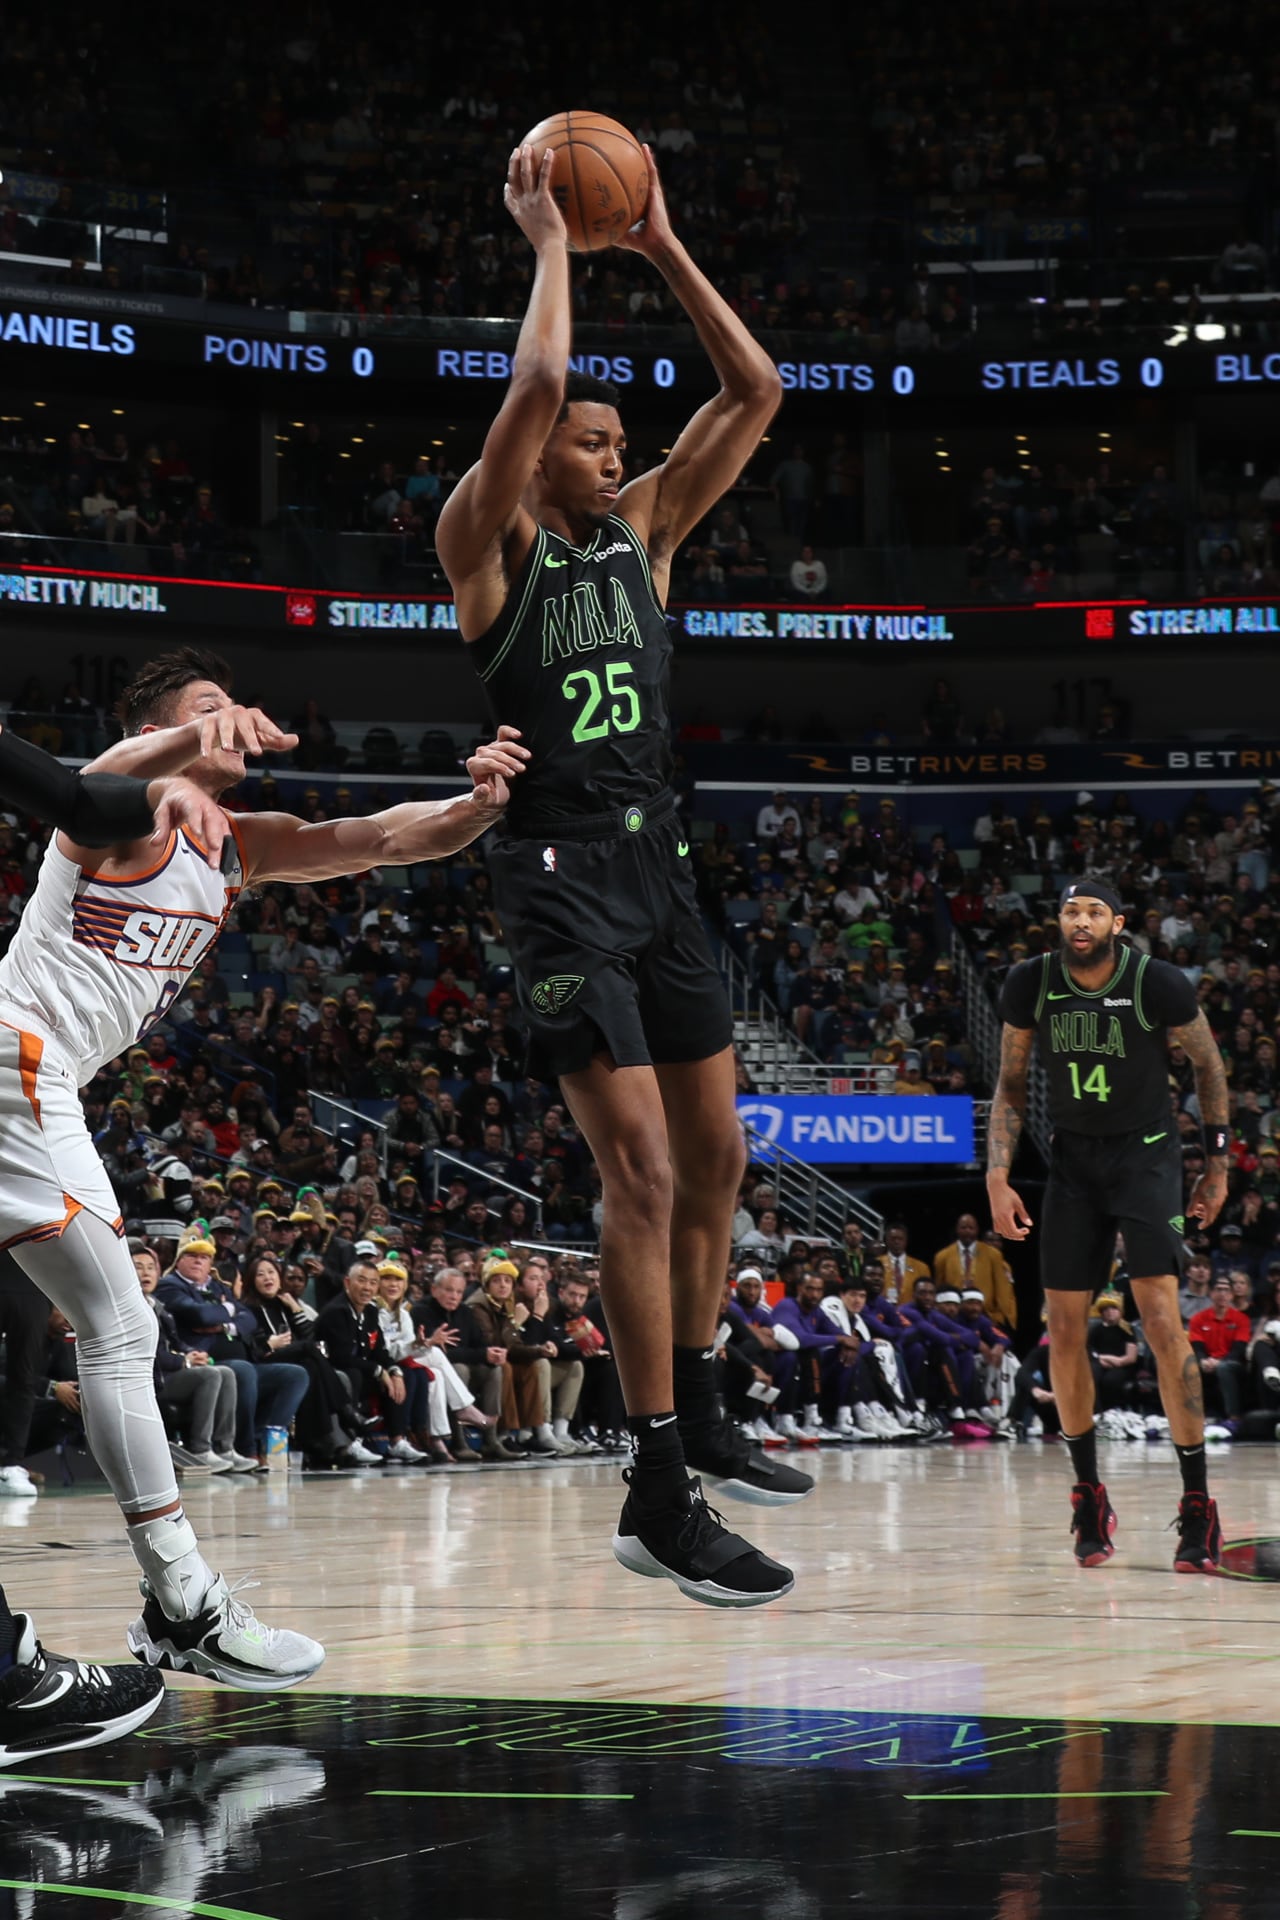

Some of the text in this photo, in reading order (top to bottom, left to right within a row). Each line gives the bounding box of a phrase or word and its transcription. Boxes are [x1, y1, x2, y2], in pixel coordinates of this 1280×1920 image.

[120, 300, 164, 313] TICKETS
[0, 311, 136, 355] ANIELS
[203, 335, 328, 373] POINTS
[352, 347, 374, 377] 0
[437, 350, 634, 383] REBNDS
[653, 358, 675, 388] 0
[777, 362, 875, 391] SISTS
[892, 365, 915, 395] 0
[982, 360, 1121, 389] STEALS
[1140, 357, 1163, 388] 0
[592, 541, 632, 563] ibotta
[89, 581, 166, 612] MUCH.
[328, 601, 427, 628] STREAM
[430, 604, 458, 630] AL
[541, 577, 643, 666] NOLA
[684, 610, 953, 640] GAMES. PRETTY MUCH.
[1129, 607, 1280, 635] STREAM ALL
[561, 662, 641, 743] 25
[850, 754, 1047, 774] BETRIVERS
[1168, 751, 1280, 769] BETRI
[1103, 998, 1133, 1007] ibotta
[1050, 1011, 1126, 1058] NOLA
[1067, 1062, 1112, 1103] 14
[791, 1115, 956, 1144] FANDUEL
